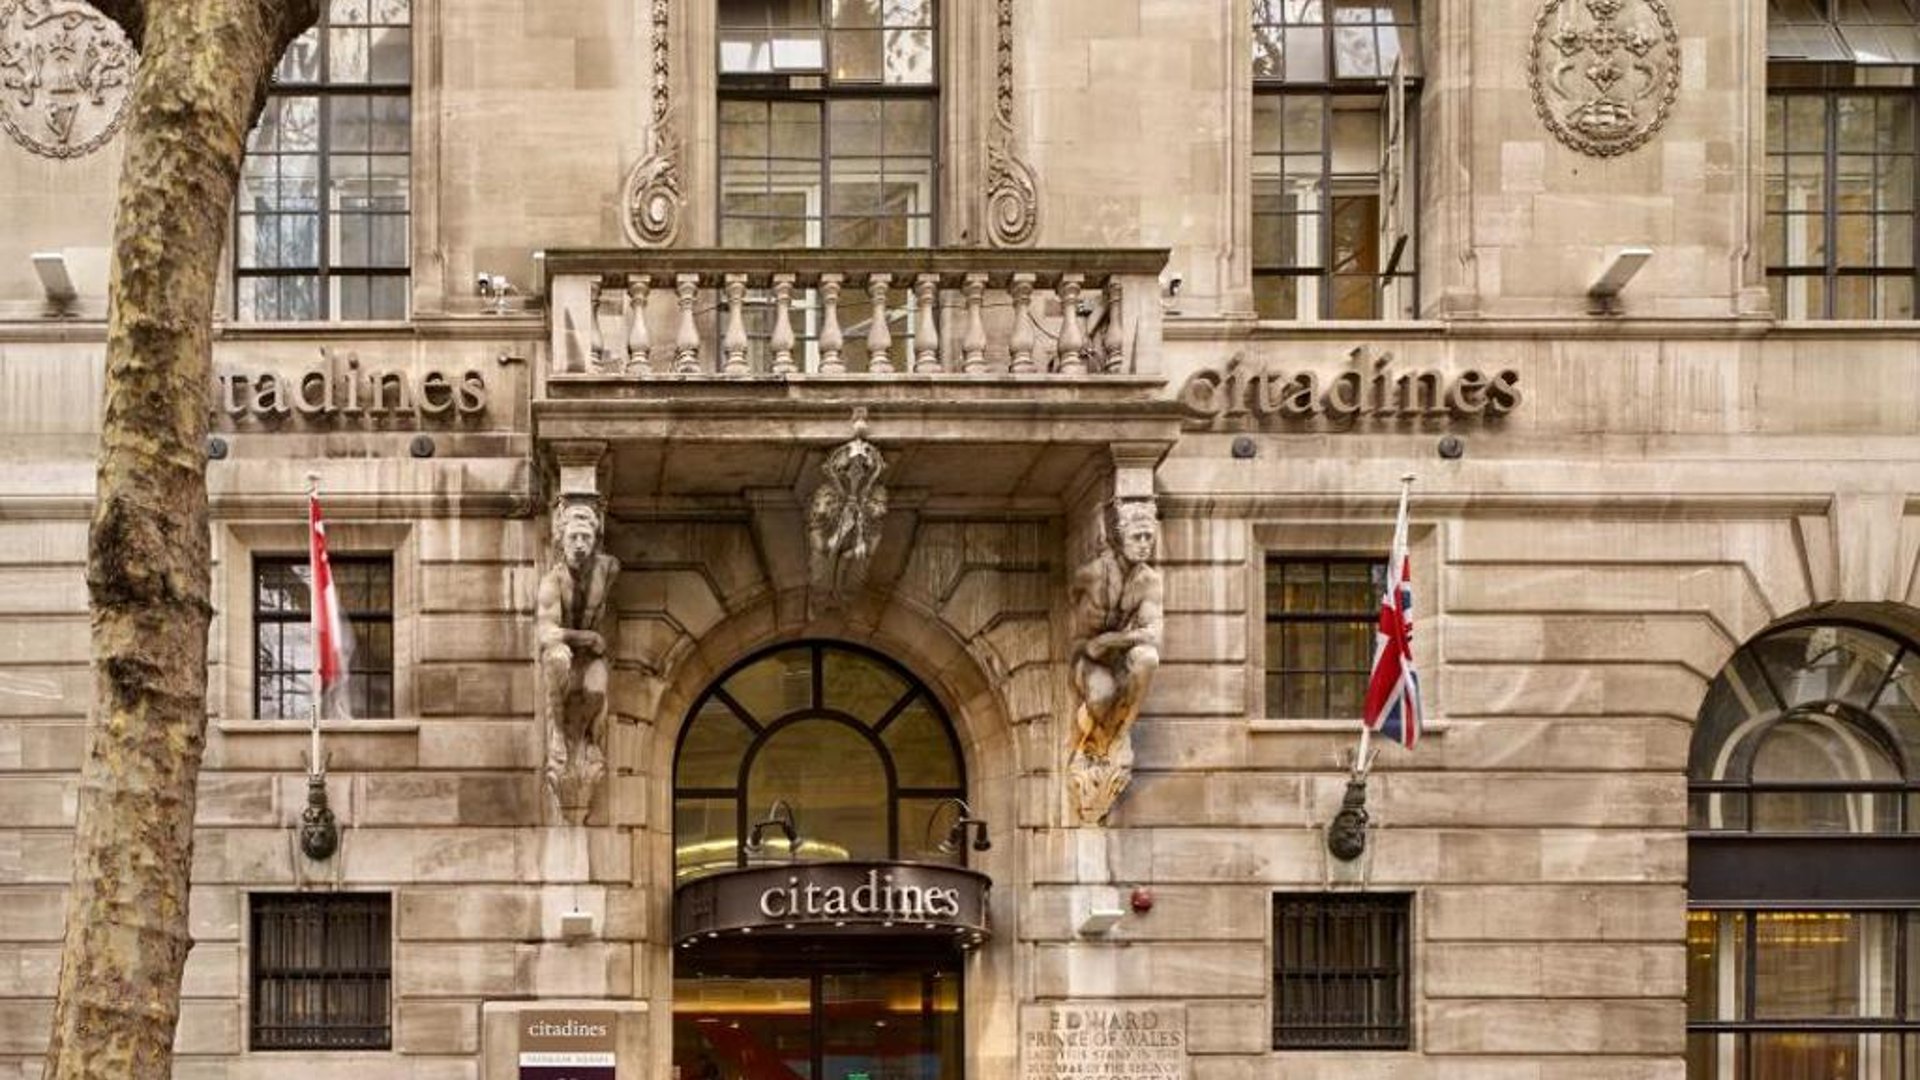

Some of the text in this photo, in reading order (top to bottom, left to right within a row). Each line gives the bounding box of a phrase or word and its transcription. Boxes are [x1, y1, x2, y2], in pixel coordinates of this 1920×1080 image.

[213, 347, 487, 417] tadines
[1178, 345, 1522, 414] citadines
[760, 869, 960, 917] citadines
[528, 1019, 607, 1037] citadines
[1050, 1011, 1158, 1030] EDWARD
[1026, 1031, 1181, 1047] PRINCE OF WALES
